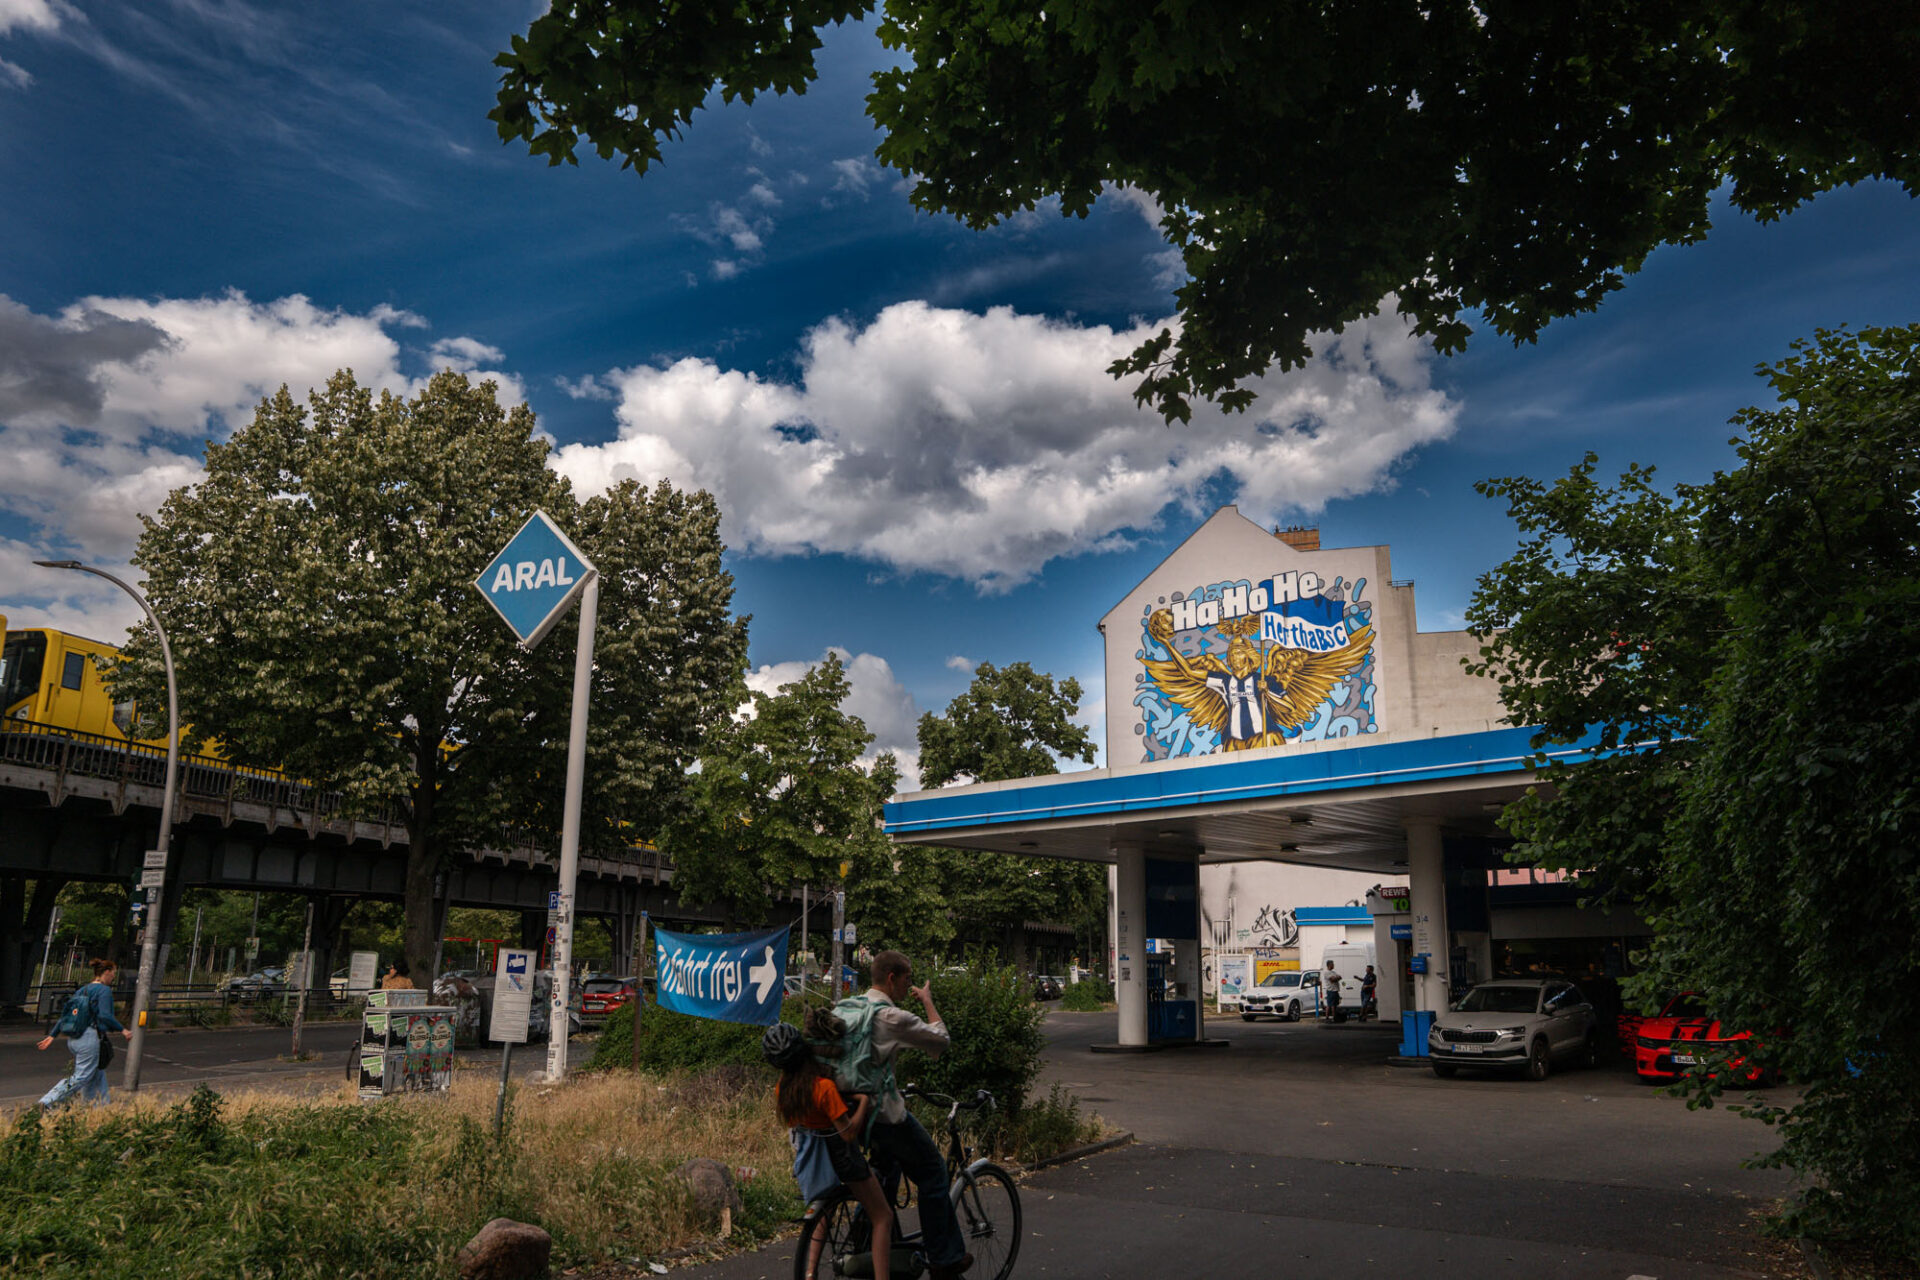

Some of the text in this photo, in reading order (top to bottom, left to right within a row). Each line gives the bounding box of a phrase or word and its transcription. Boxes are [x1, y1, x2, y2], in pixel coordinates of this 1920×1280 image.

[492, 556, 573, 593] ARAL
[1171, 570, 1319, 633] Ha Ho He
[1382, 888, 1407, 897] REWE
[1392, 898, 1409, 911] TO
[709, 949, 748, 1002] frei
